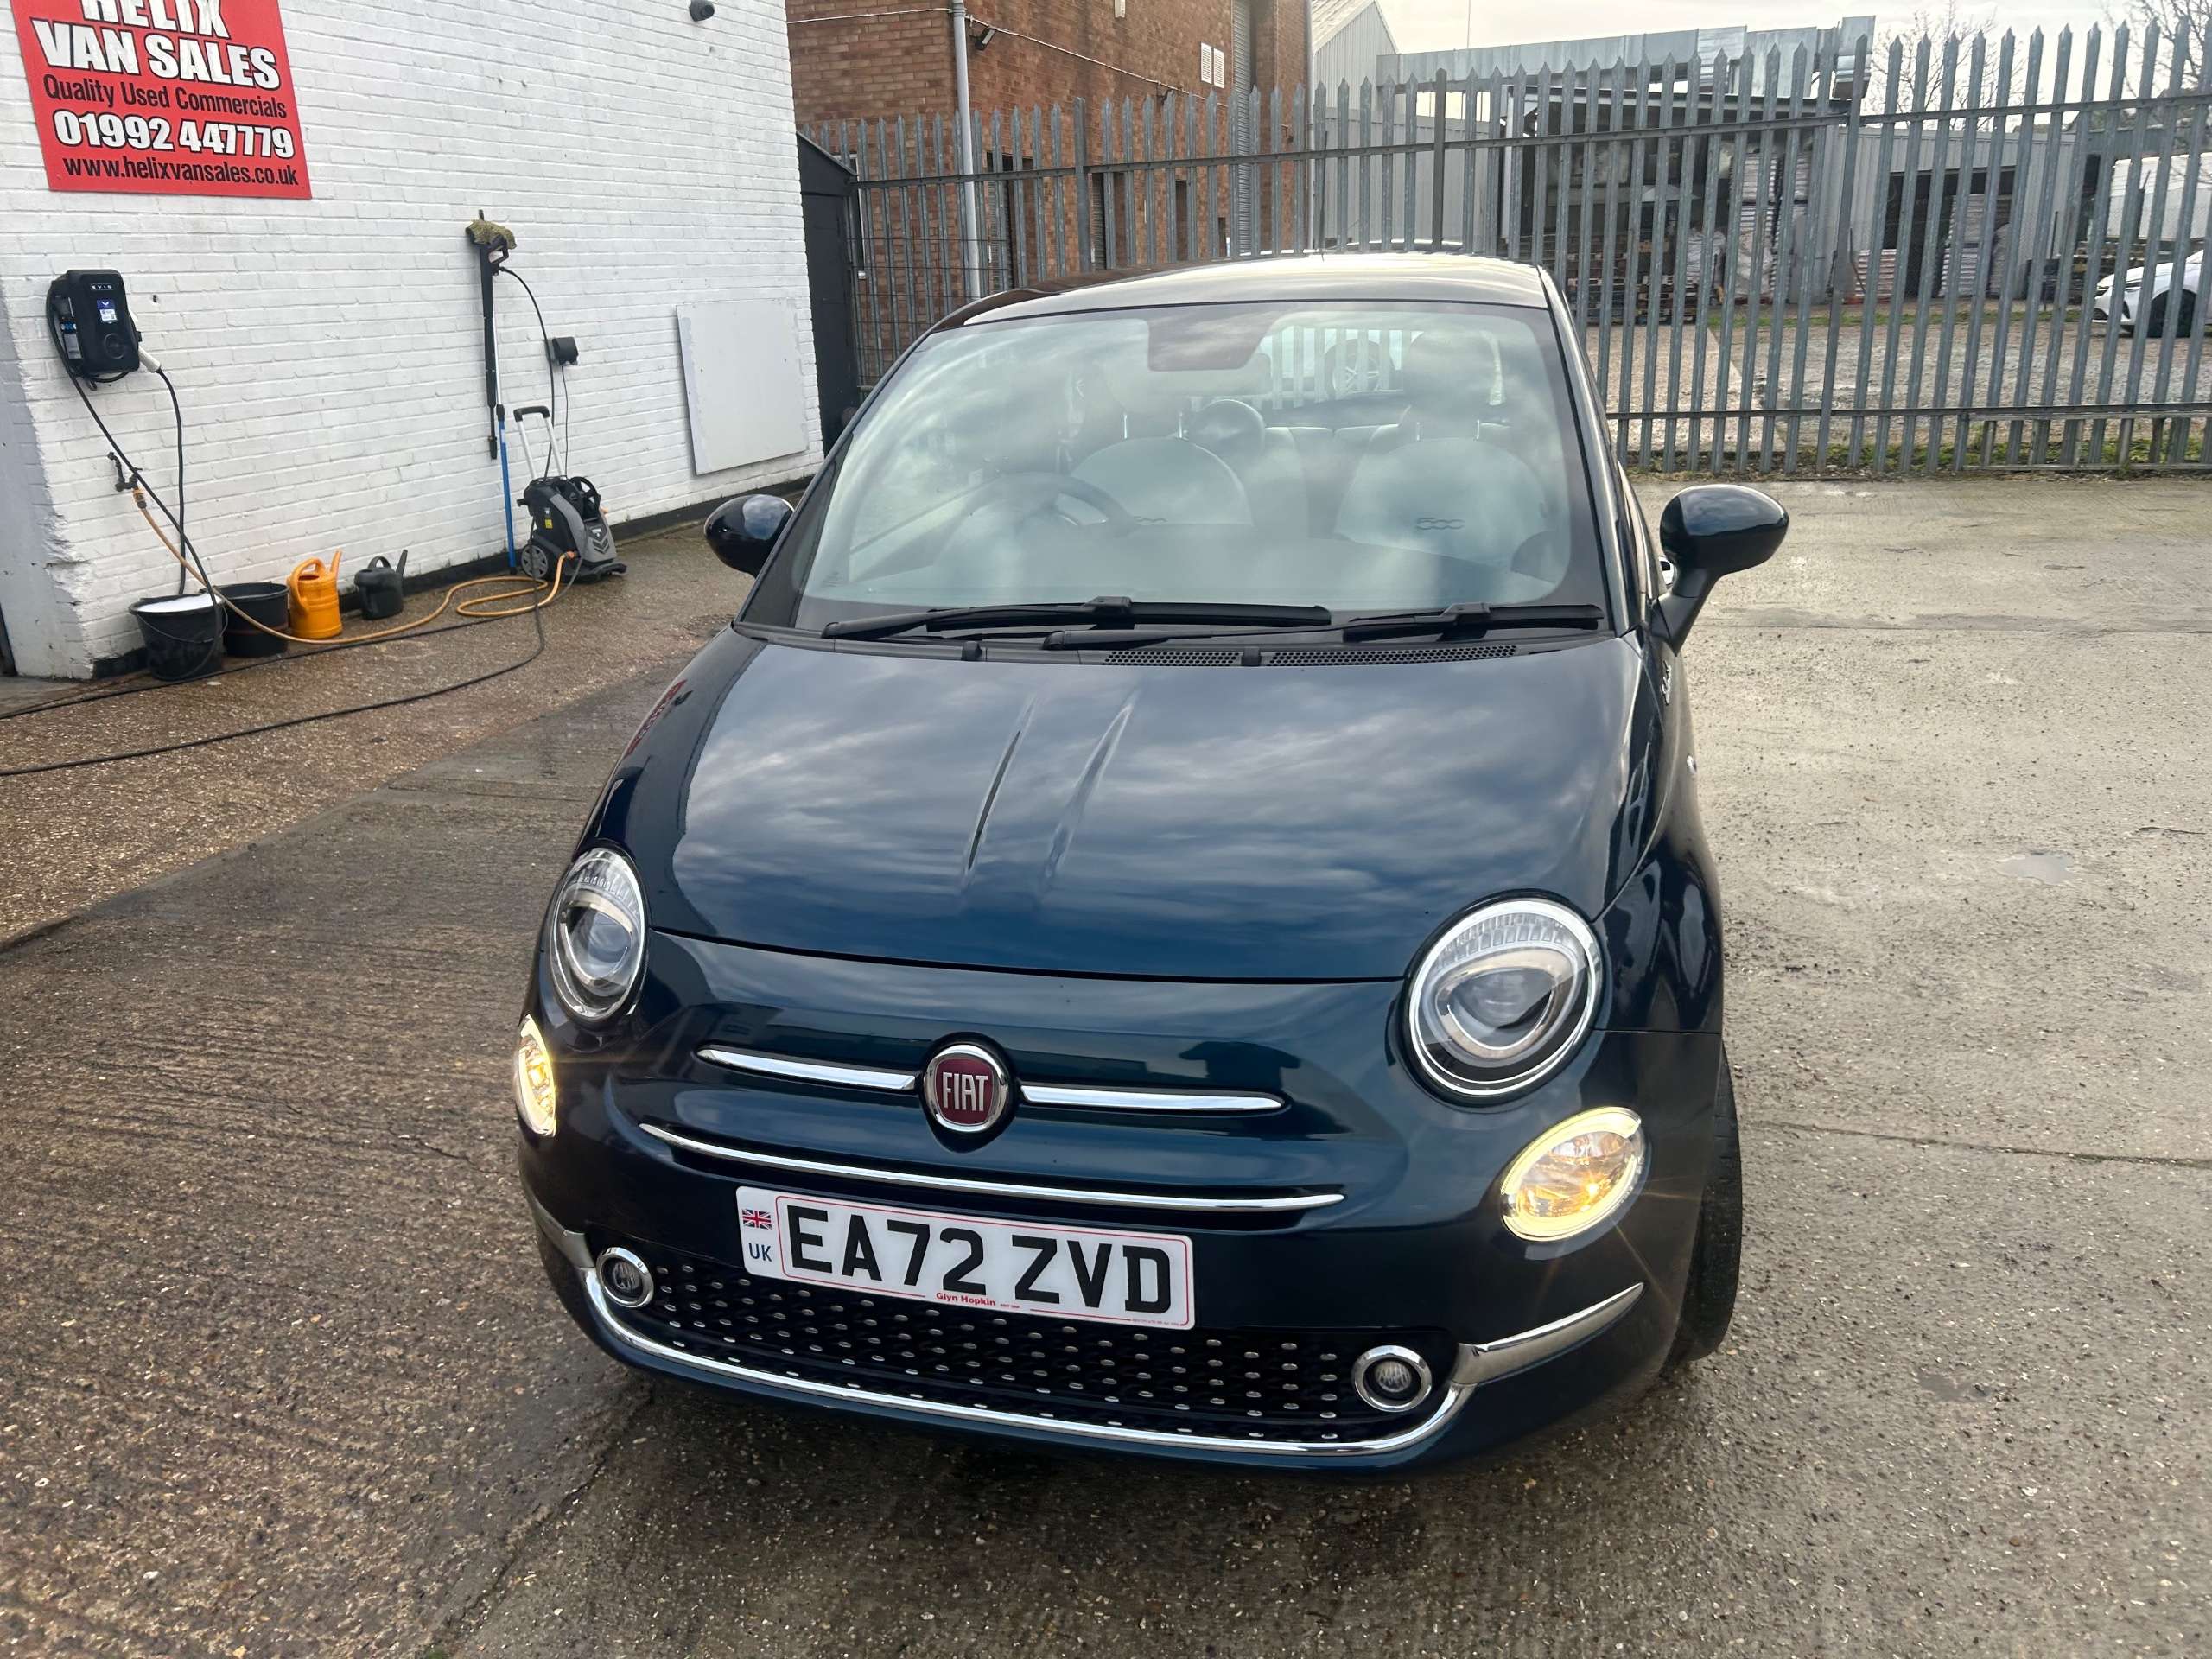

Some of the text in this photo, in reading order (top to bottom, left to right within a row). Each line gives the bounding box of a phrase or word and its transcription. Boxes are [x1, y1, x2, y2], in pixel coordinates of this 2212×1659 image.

[31, 17, 281, 90] VAN SALES
[43, 74, 286, 118] Quality Used Commercials
[53, 110, 296, 158] 01992 447779
[63, 156, 299, 185] www.helixvansales.co.uk
[942, 1071, 988, 1111] FIAT
[748, 1243, 772, 1262] UK
[786, 1205, 1171, 1314] EA72 ZVD
[936, 1292, 958, 1302] Glyn
[961, 1295, 996, 1306] Hopkin
